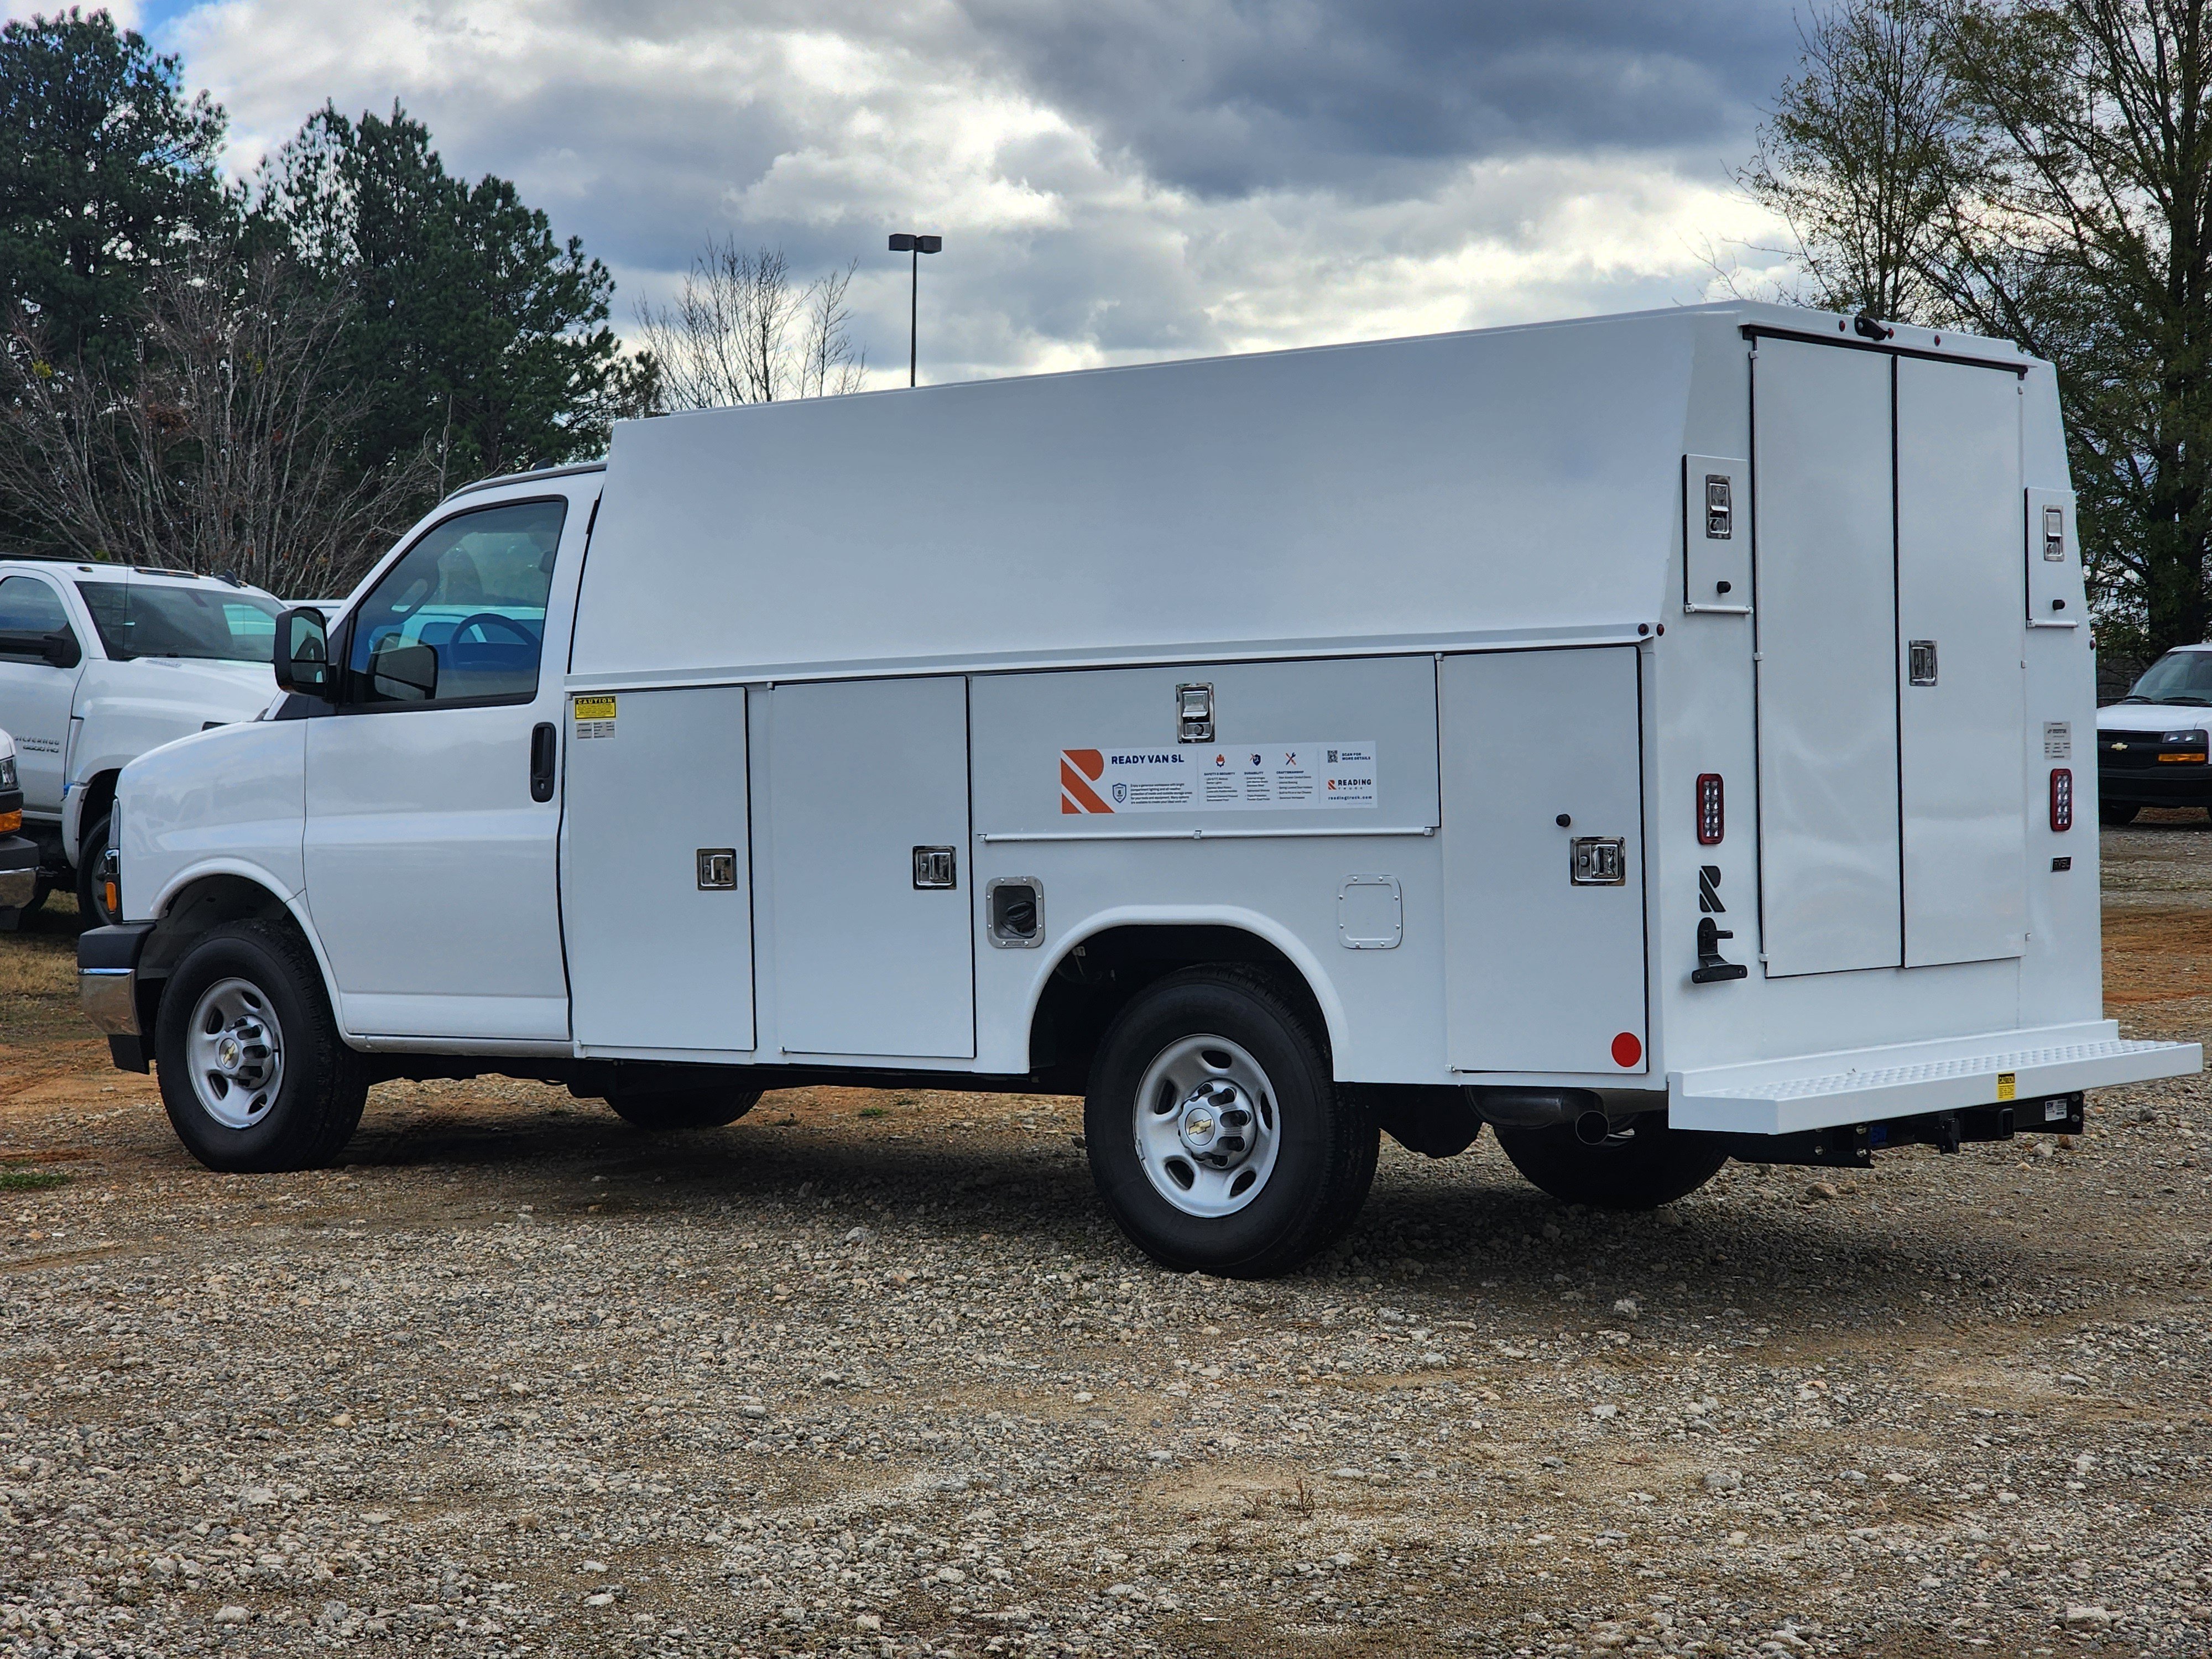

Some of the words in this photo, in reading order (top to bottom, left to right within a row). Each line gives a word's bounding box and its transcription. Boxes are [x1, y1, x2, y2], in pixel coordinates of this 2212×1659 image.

[1111, 755, 1146, 764] READY
[1147, 754, 1169, 763] VAN
[1171, 754, 1185, 763] SL
